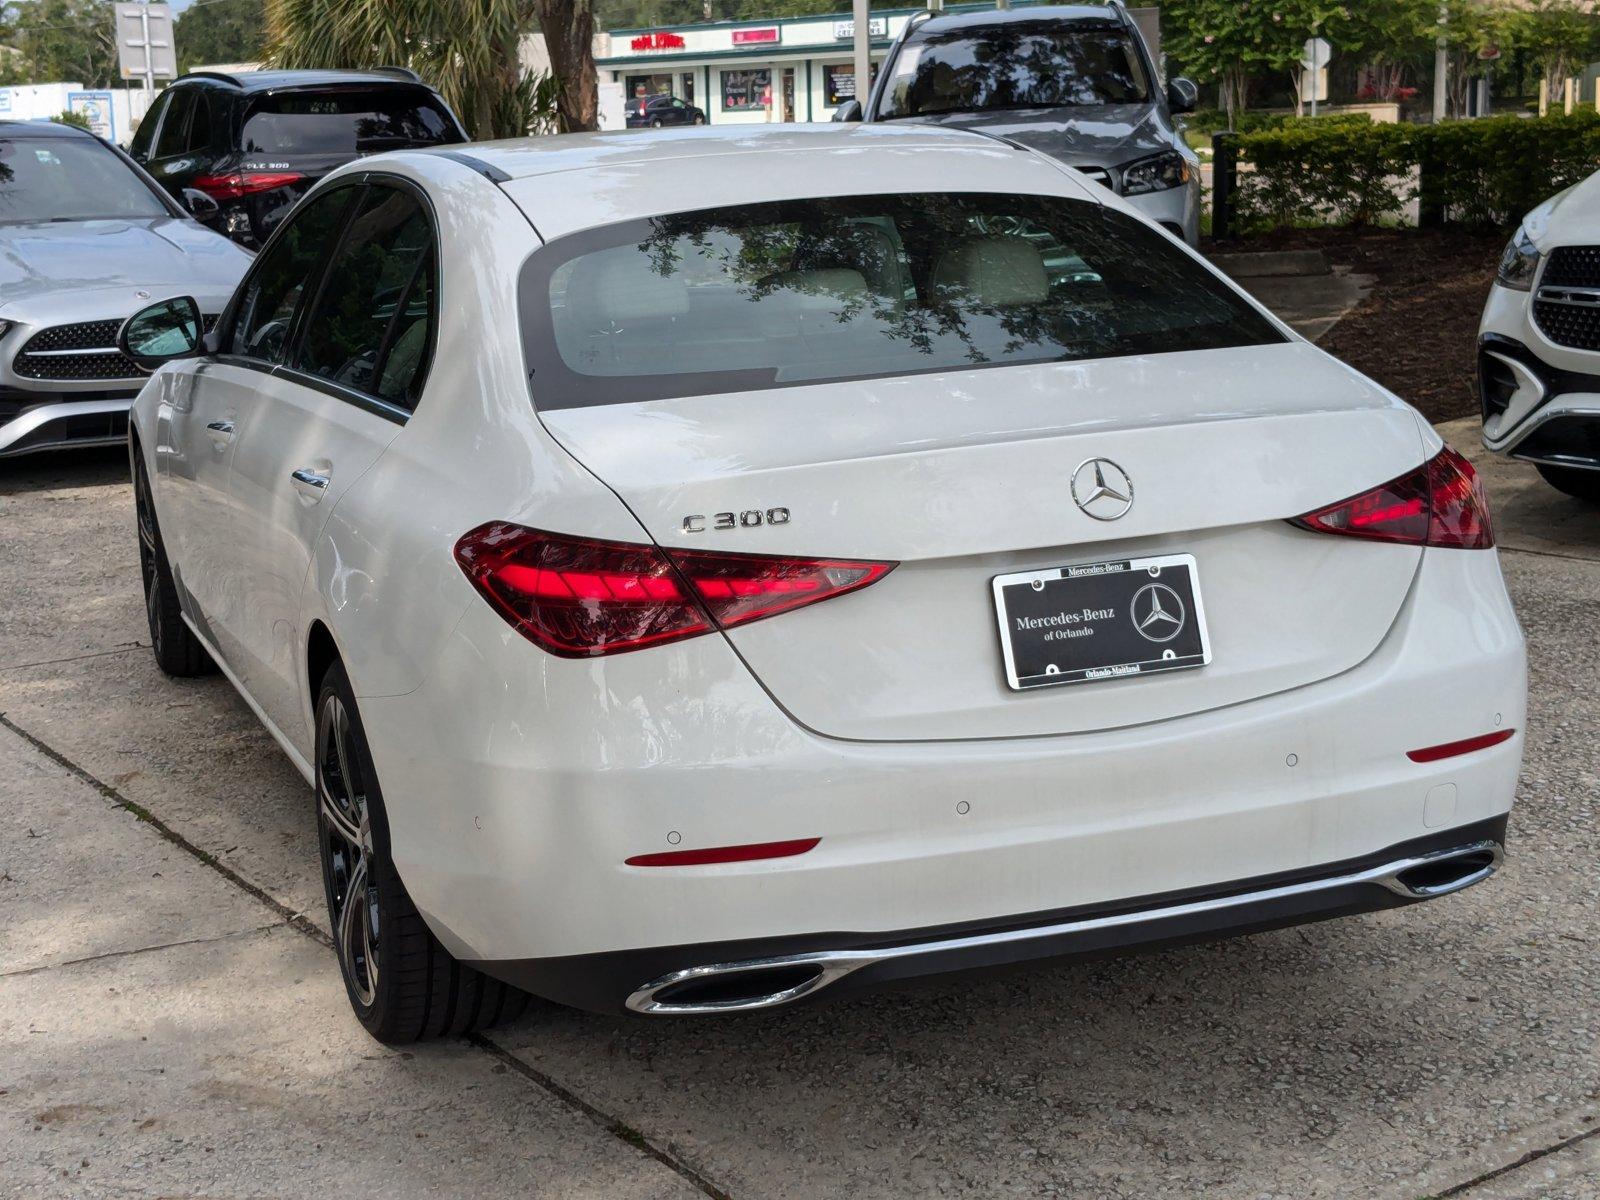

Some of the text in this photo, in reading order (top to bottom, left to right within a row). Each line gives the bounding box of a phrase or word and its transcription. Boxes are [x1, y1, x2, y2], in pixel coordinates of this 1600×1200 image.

[682, 507, 791, 533] C 300
[1068, 562, 1124, 577] Mercedes-Benz
[1016, 607, 1115, 631] Mercedes-Benz
[1044, 626, 1094, 642] of Orlando
[1085, 664, 1141, 679] Orlando-Maitland
